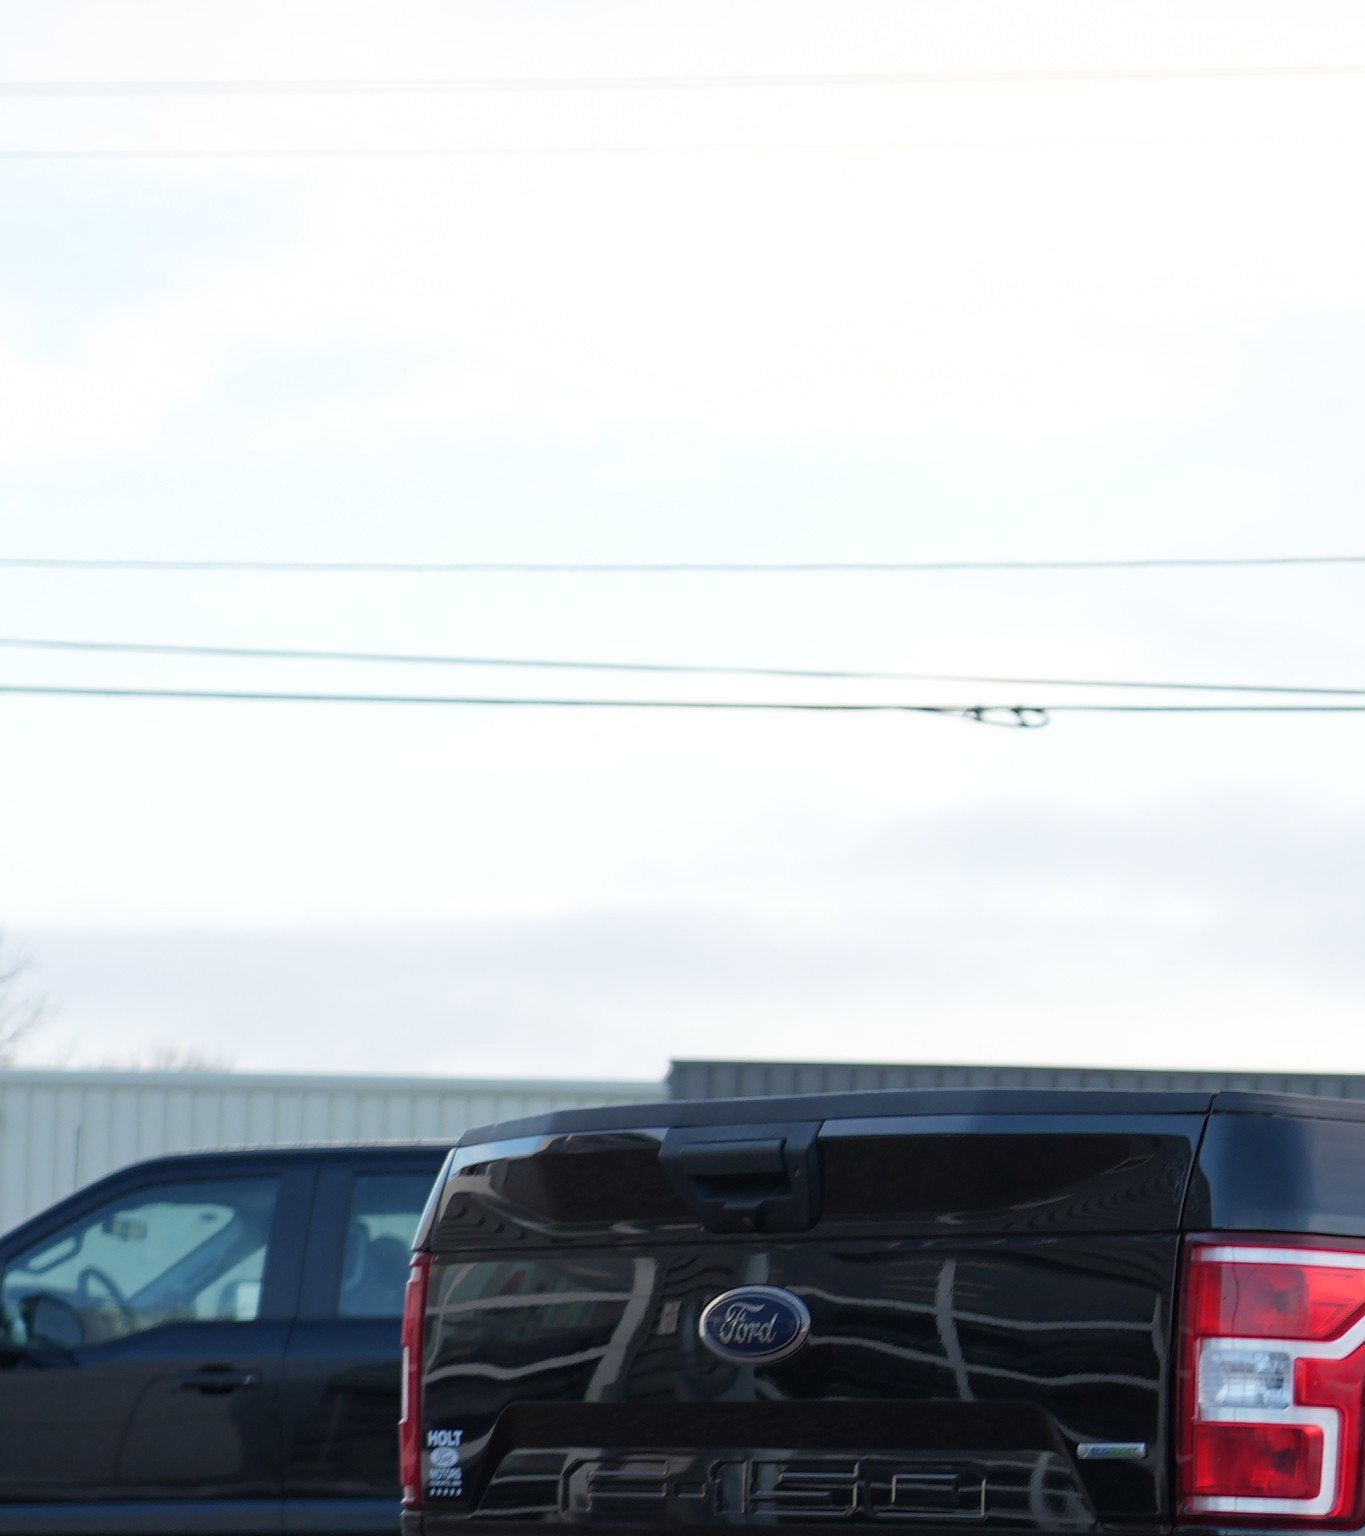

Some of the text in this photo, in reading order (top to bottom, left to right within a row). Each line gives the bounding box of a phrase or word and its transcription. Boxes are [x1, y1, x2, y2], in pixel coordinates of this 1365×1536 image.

[718, 1301, 779, 1345] Ford
[427, 1429, 464, 1448] HOLT
[561, 1457, 987, 1521] F-150
